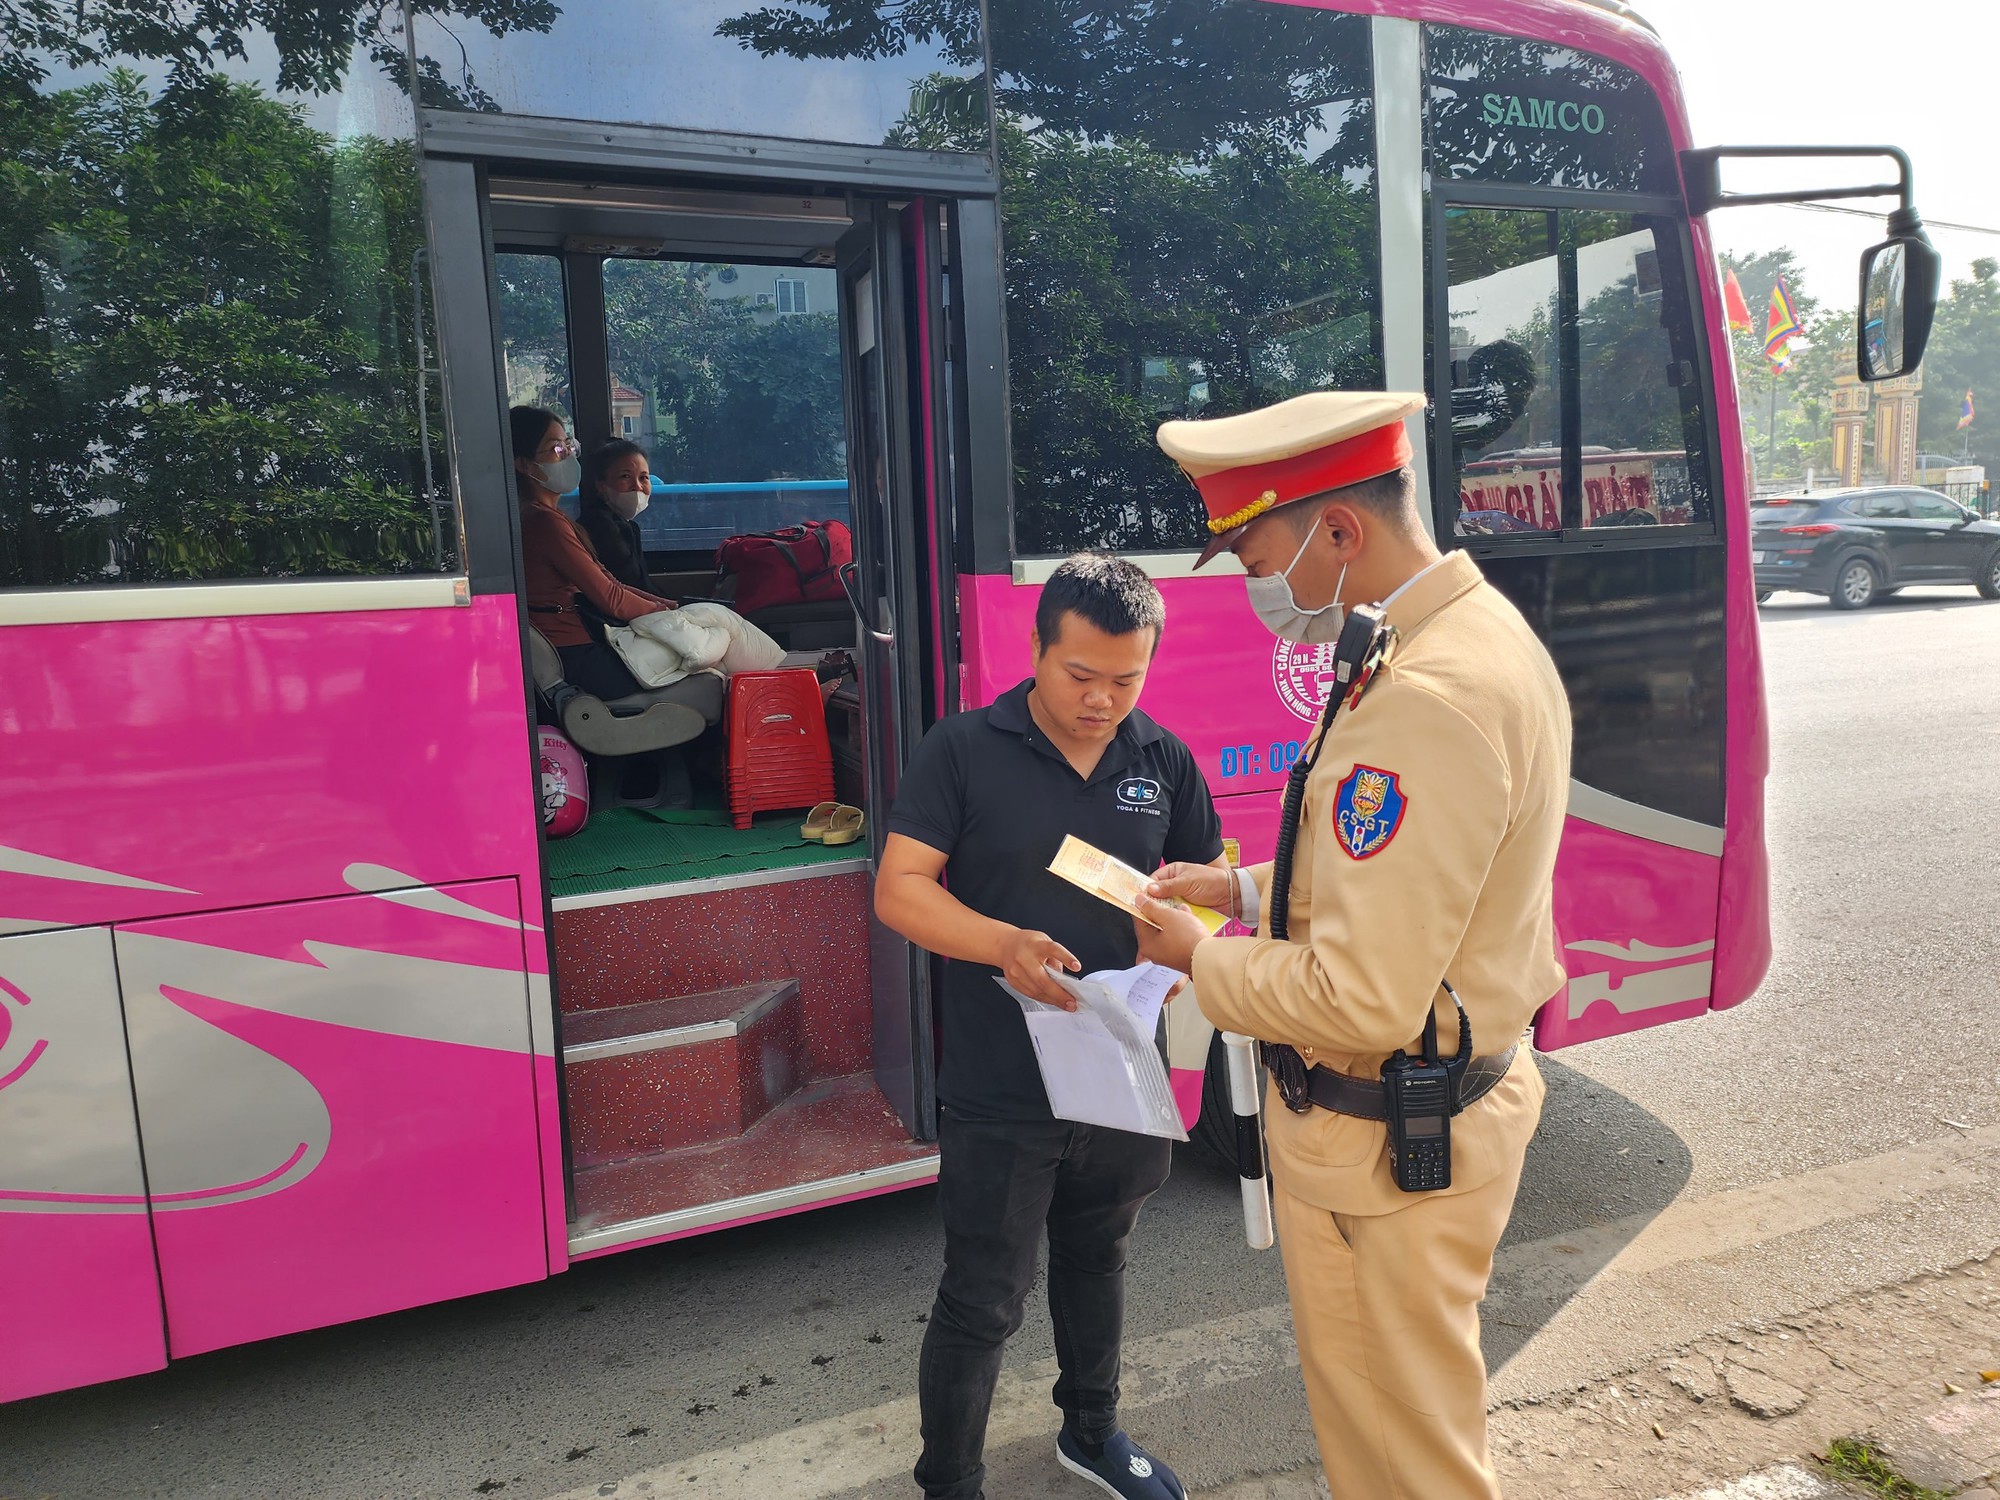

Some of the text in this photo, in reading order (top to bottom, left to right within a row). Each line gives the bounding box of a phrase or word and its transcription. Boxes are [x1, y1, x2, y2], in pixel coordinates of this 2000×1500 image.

[1483, 93, 1605, 134] SAMCO
[802, 200, 812, 209] 32
[1276, 638, 1293, 670] CÔNG
[1279, 679, 1296, 703] XUÂN
[543, 738, 568, 750] Kitty
[1220, 740, 1308, 779] ĐT: 09
[1140, 808, 1161, 816] FITNESS
[1340, 810, 1389, 833] CSGT
